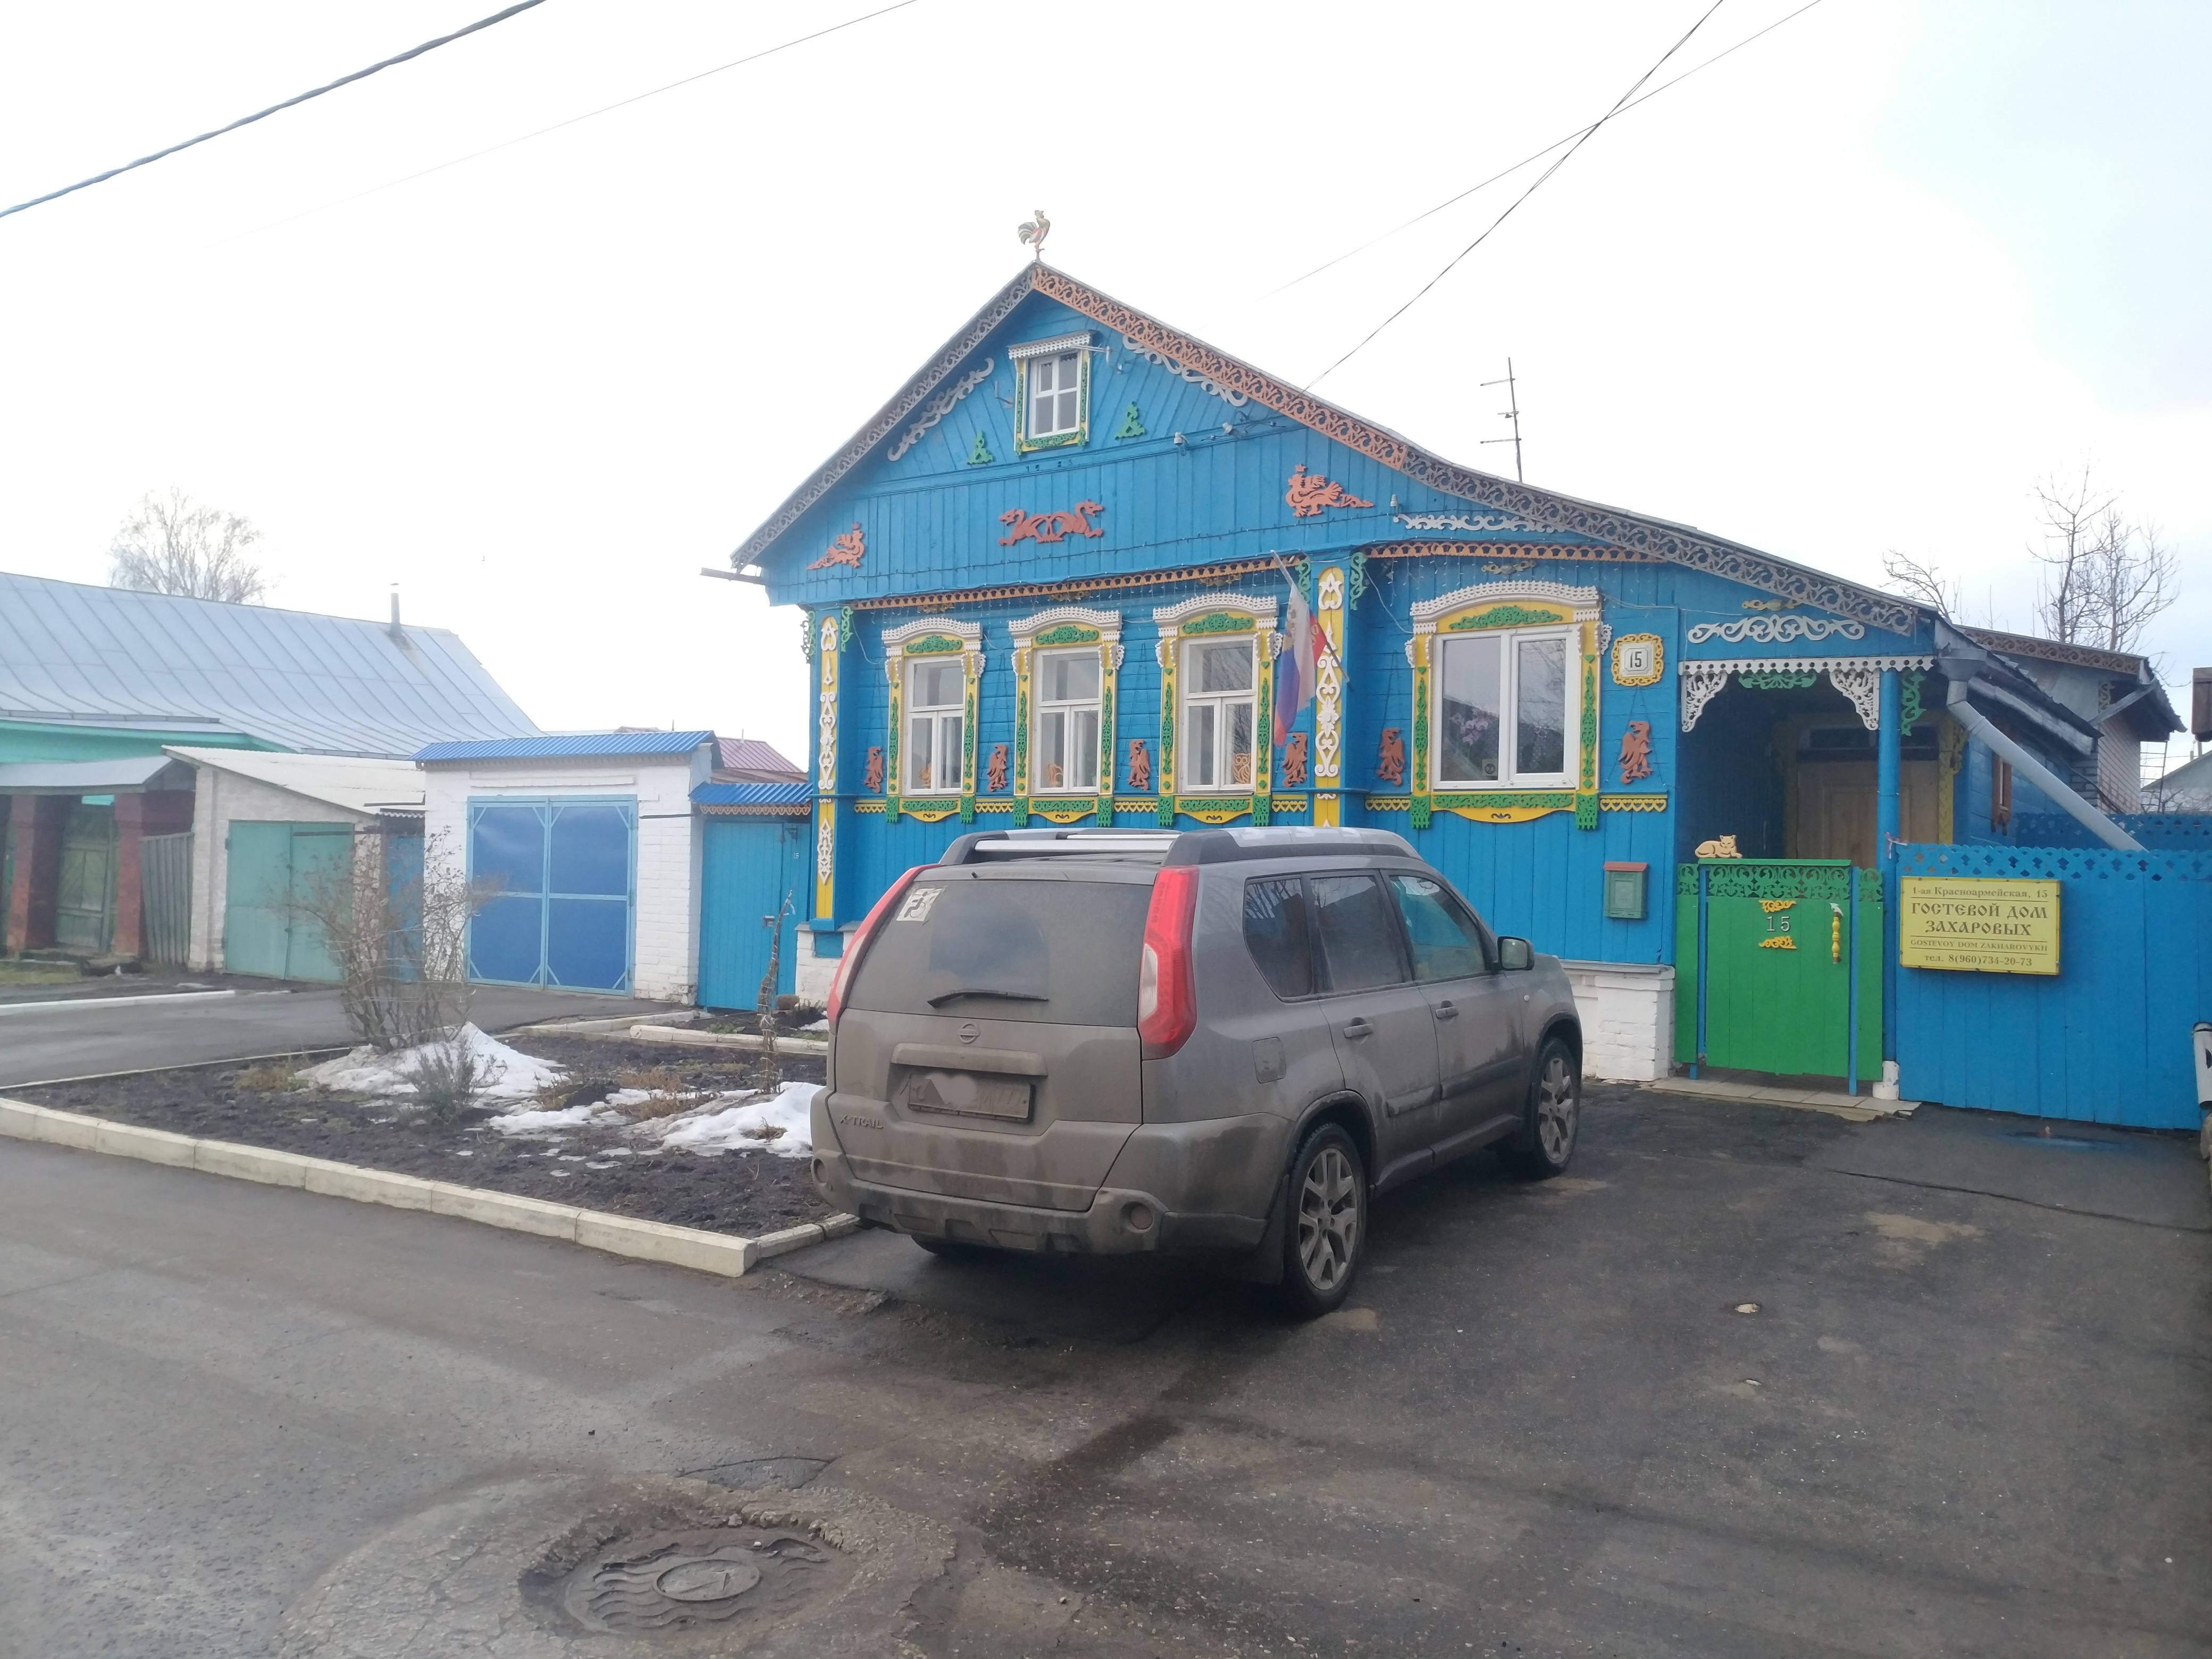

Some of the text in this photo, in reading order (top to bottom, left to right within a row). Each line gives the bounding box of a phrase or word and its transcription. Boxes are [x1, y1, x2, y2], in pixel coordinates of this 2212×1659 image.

[1629, 651, 1643, 668] 15
[1934, 886, 2031, 899] Красноармейская,
[2037, 890, 2048, 898] 15
[1912, 902, 2048, 920] ГОСТЕВОЙ ДОМ
[1766, 916, 1790, 932] 15
[1925, 920, 2032, 936] ЗАХАРОВЫХ
[1980, 943, 2047, 951] ZAKHAROVYKH
[1948, 954, 2032, 966] 8(960)734-20-73
